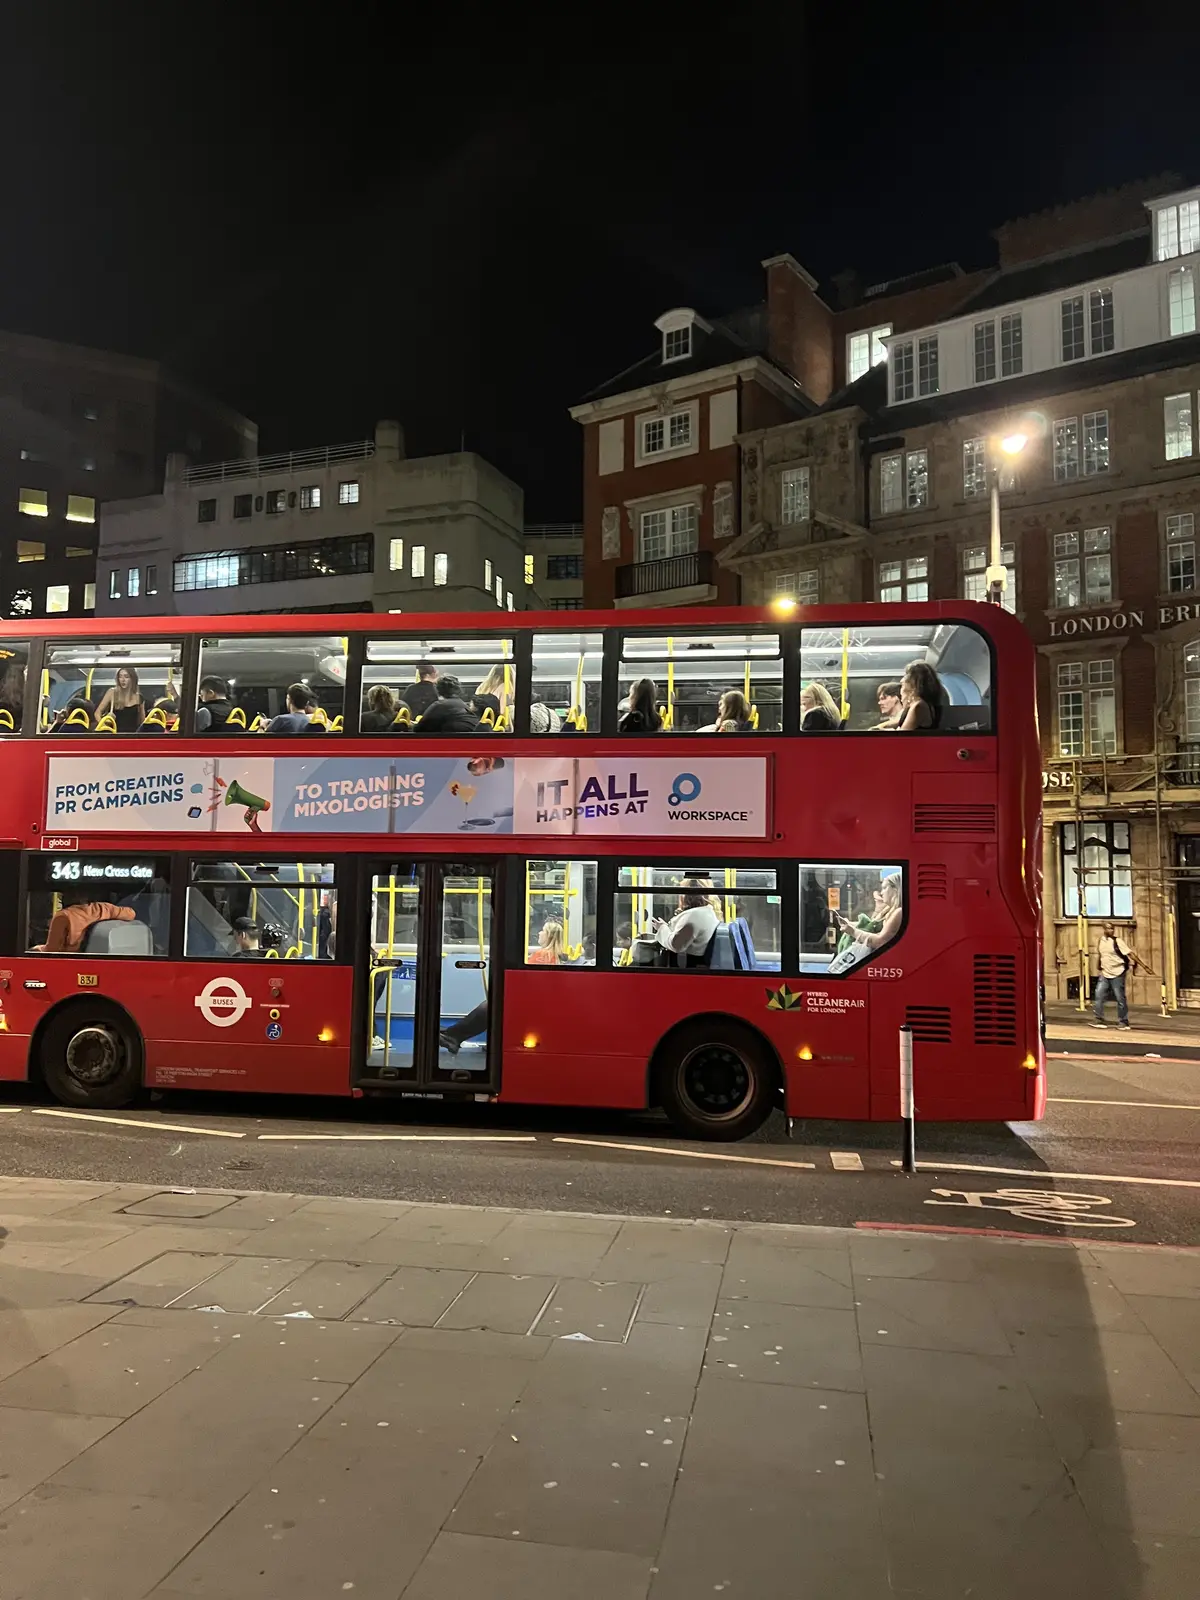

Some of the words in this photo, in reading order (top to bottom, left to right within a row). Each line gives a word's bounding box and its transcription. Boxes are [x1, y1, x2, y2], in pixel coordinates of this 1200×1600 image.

[1050, 611, 1145, 636] LONDON
[56, 782, 100, 798] FROM
[104, 772, 184, 793] CREATING
[295, 783, 323, 800] TO
[327, 772, 425, 797] TRAINING
[536, 779, 569, 807] IT
[579, 772, 649, 803] ALL
[55, 800, 77, 815] PR
[81, 788, 184, 812] CAMPAIGNS
[294, 790, 425, 818] MIXOLOGISTS
[536, 802, 620, 823] HAPPENS
[624, 799, 648, 815] AT
[667, 810, 748, 821] WORKSPACE
[49, 838, 71, 849] global
[51, 861, 80, 880] 343
[83, 865, 104, 877] New
[104, 865, 130, 878] Cross
[130, 865, 153, 878] Gate
[867, 967, 903, 977] EH259
[212, 998, 234, 1006] BUSES
